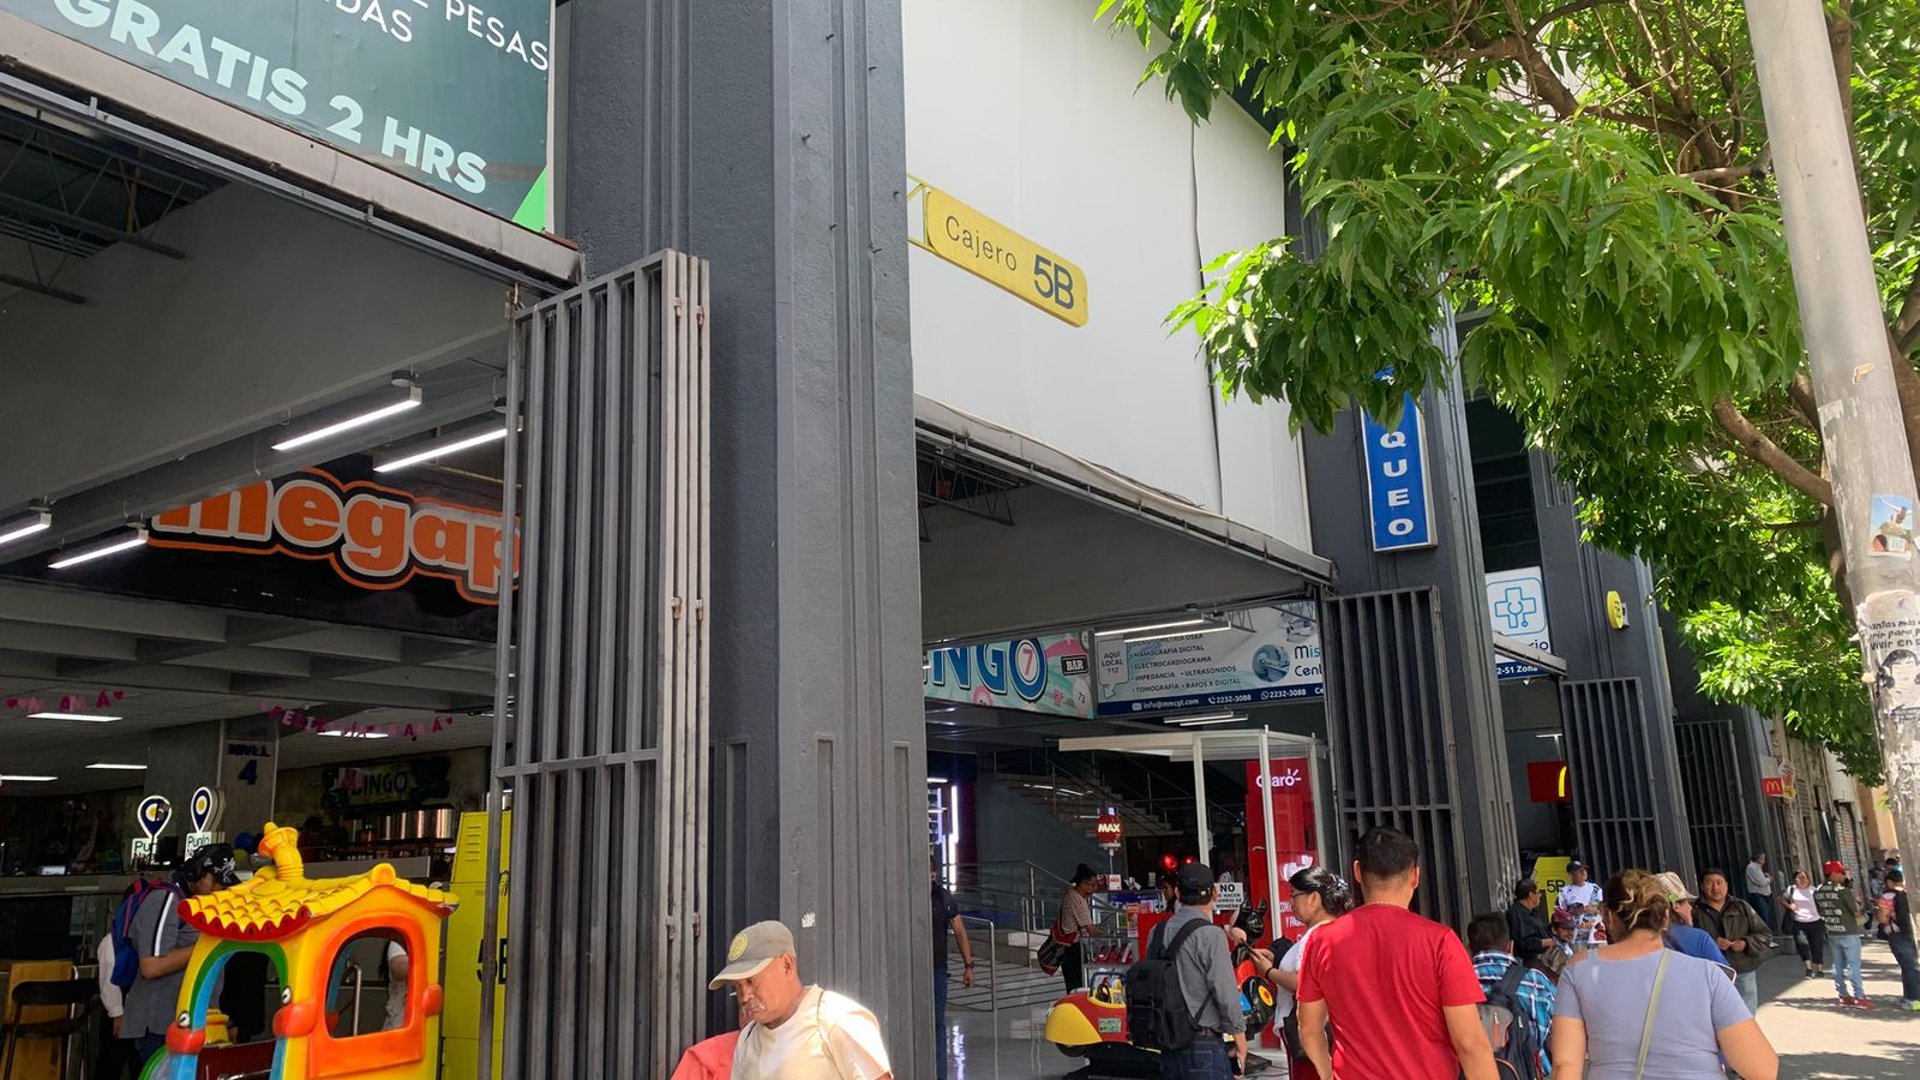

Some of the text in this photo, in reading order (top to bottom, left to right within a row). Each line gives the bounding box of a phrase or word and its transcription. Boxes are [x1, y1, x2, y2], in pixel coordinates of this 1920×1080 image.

[53, 0, 487, 194] GRATIS 2 HRS
[945, 215, 1075, 310] Cajero 5B
[1065, 659, 1084, 672] BAR
[1101, 659, 1123, 667] LOCAL
[238, 759, 257, 785] 4
[1097, 823, 1121, 833] MAX
[1219, 883, 1236, 892] NO
